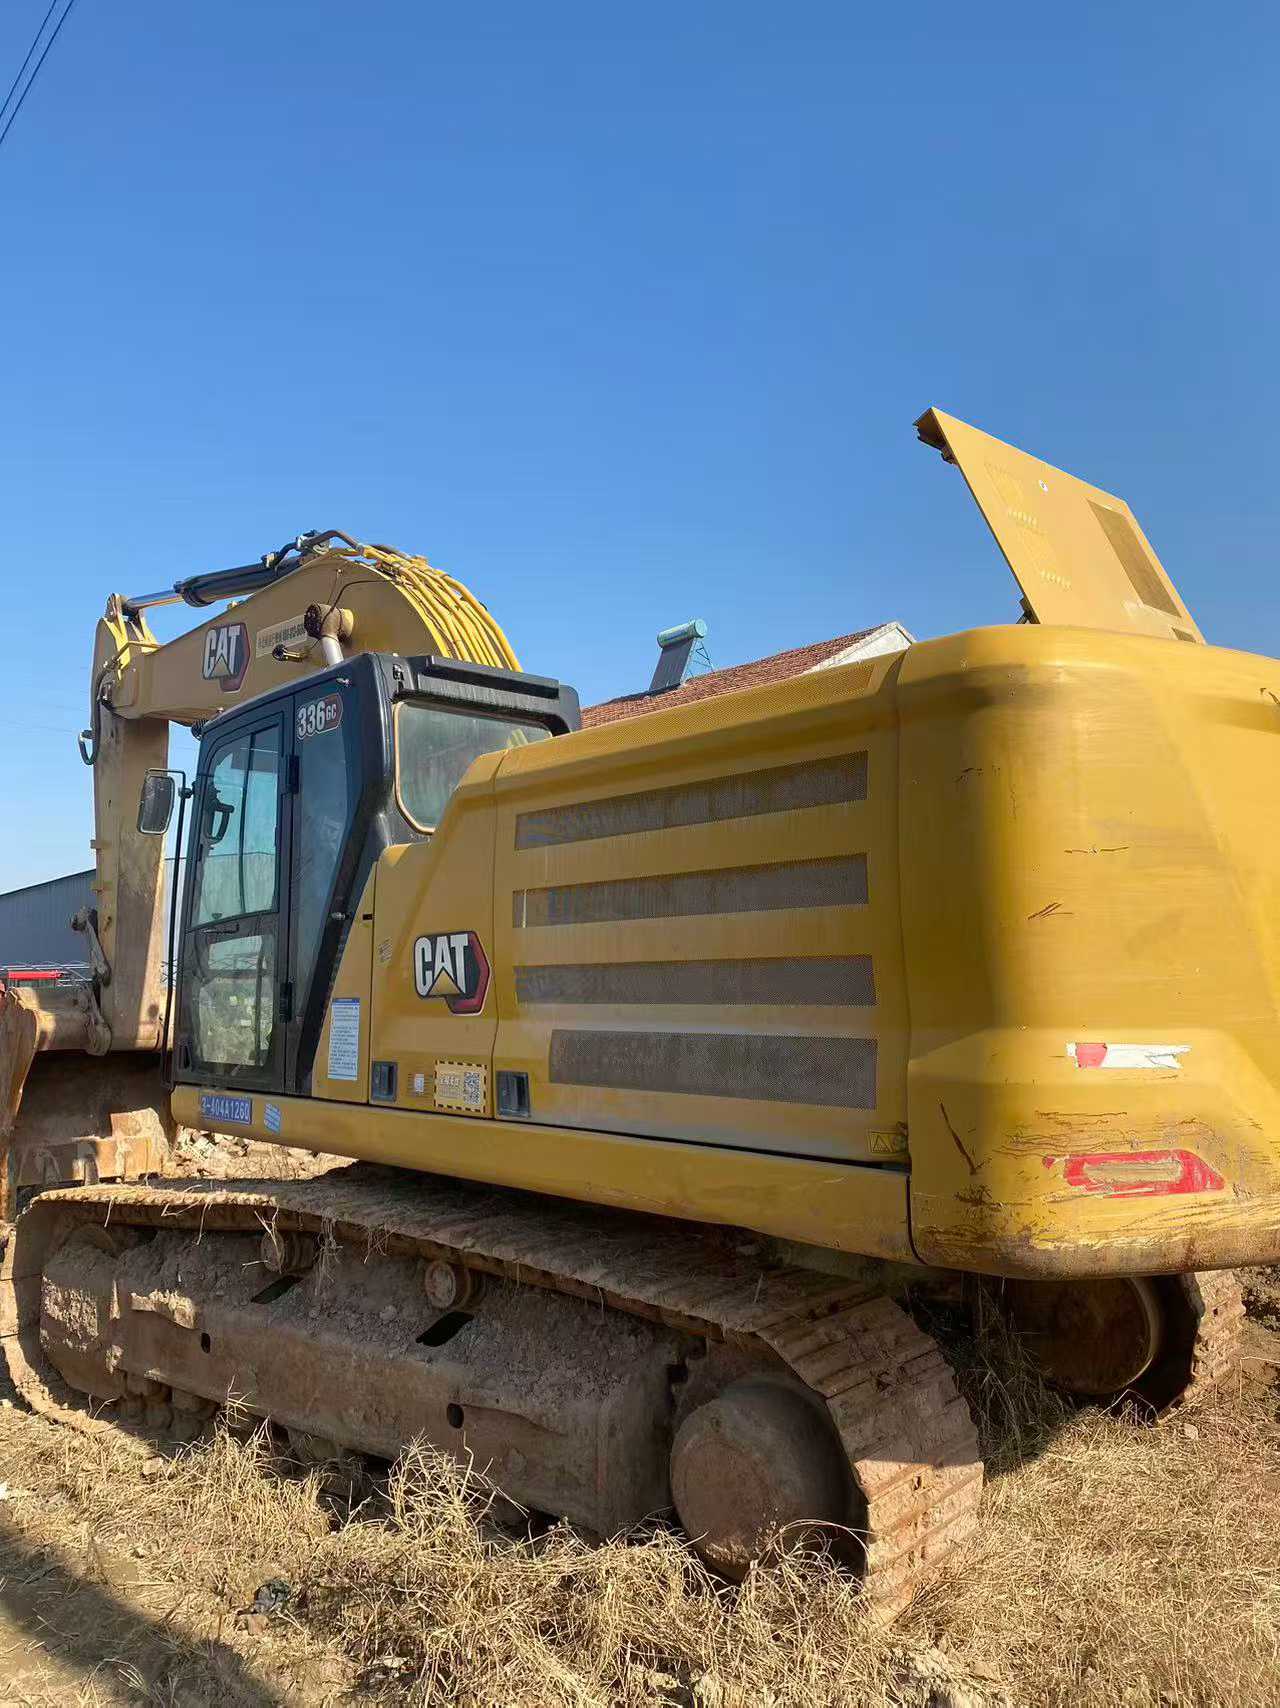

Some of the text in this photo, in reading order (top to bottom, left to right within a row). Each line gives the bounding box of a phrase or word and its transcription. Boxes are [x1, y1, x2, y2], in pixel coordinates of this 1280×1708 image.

[203, 625, 241, 678] CAT
[298, 701, 326, 736] 336
[414, 933, 469, 996] CAT
